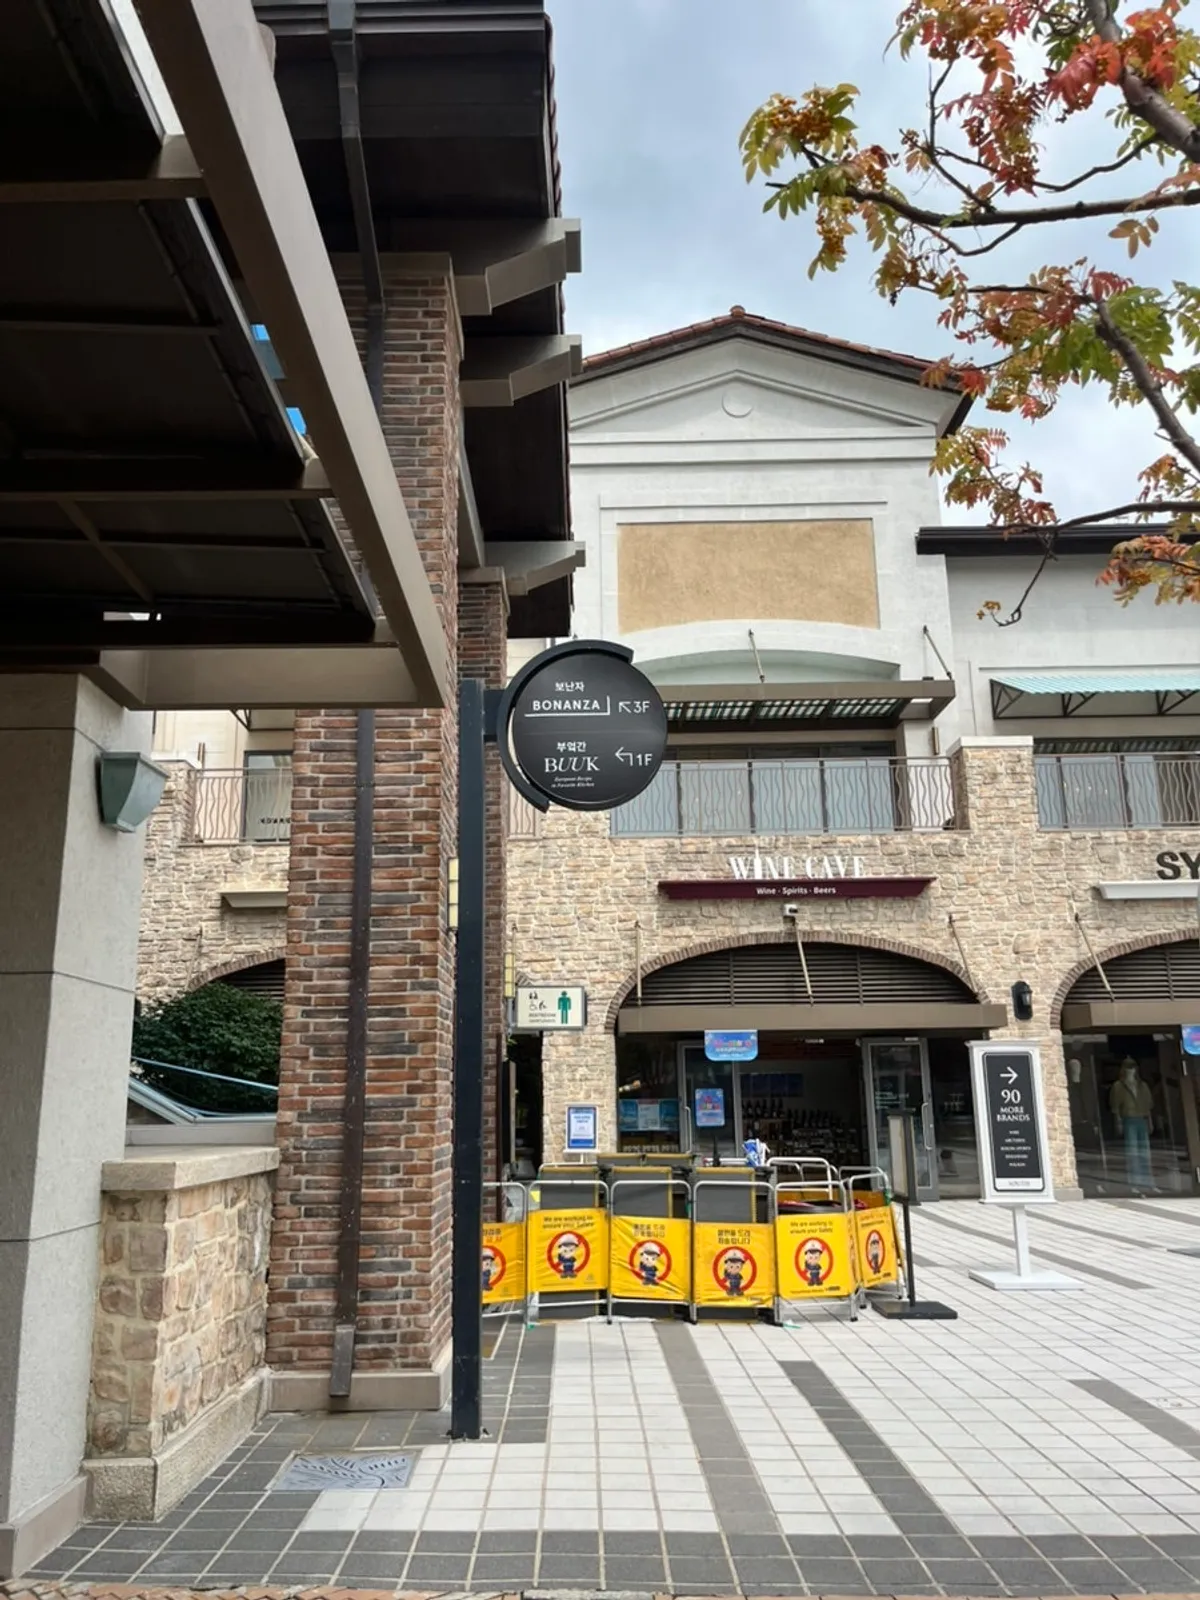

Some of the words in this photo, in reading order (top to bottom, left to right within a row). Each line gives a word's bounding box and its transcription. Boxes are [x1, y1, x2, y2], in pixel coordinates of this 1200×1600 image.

[554, 681, 586, 692] 보난자
[532, 699, 601, 711] BONANZA
[633, 701, 650, 713] 3F
[544, 756, 600, 773] BUUK
[636, 753, 653, 766] 1F
[729, 848, 796, 880] WINE
[805, 854, 866, 879] CAVE
[1156, 851, 1200, 880] SY
[756, 886, 776, 895] Wine
[782, 886, 808, 896] Spirits
[813, 886, 836, 895] Beers
[1001, 1089, 1021, 1104] 90
[1000, 1106, 1024, 1114] MORE
[997, 1114, 1030, 1122] BRANDS
